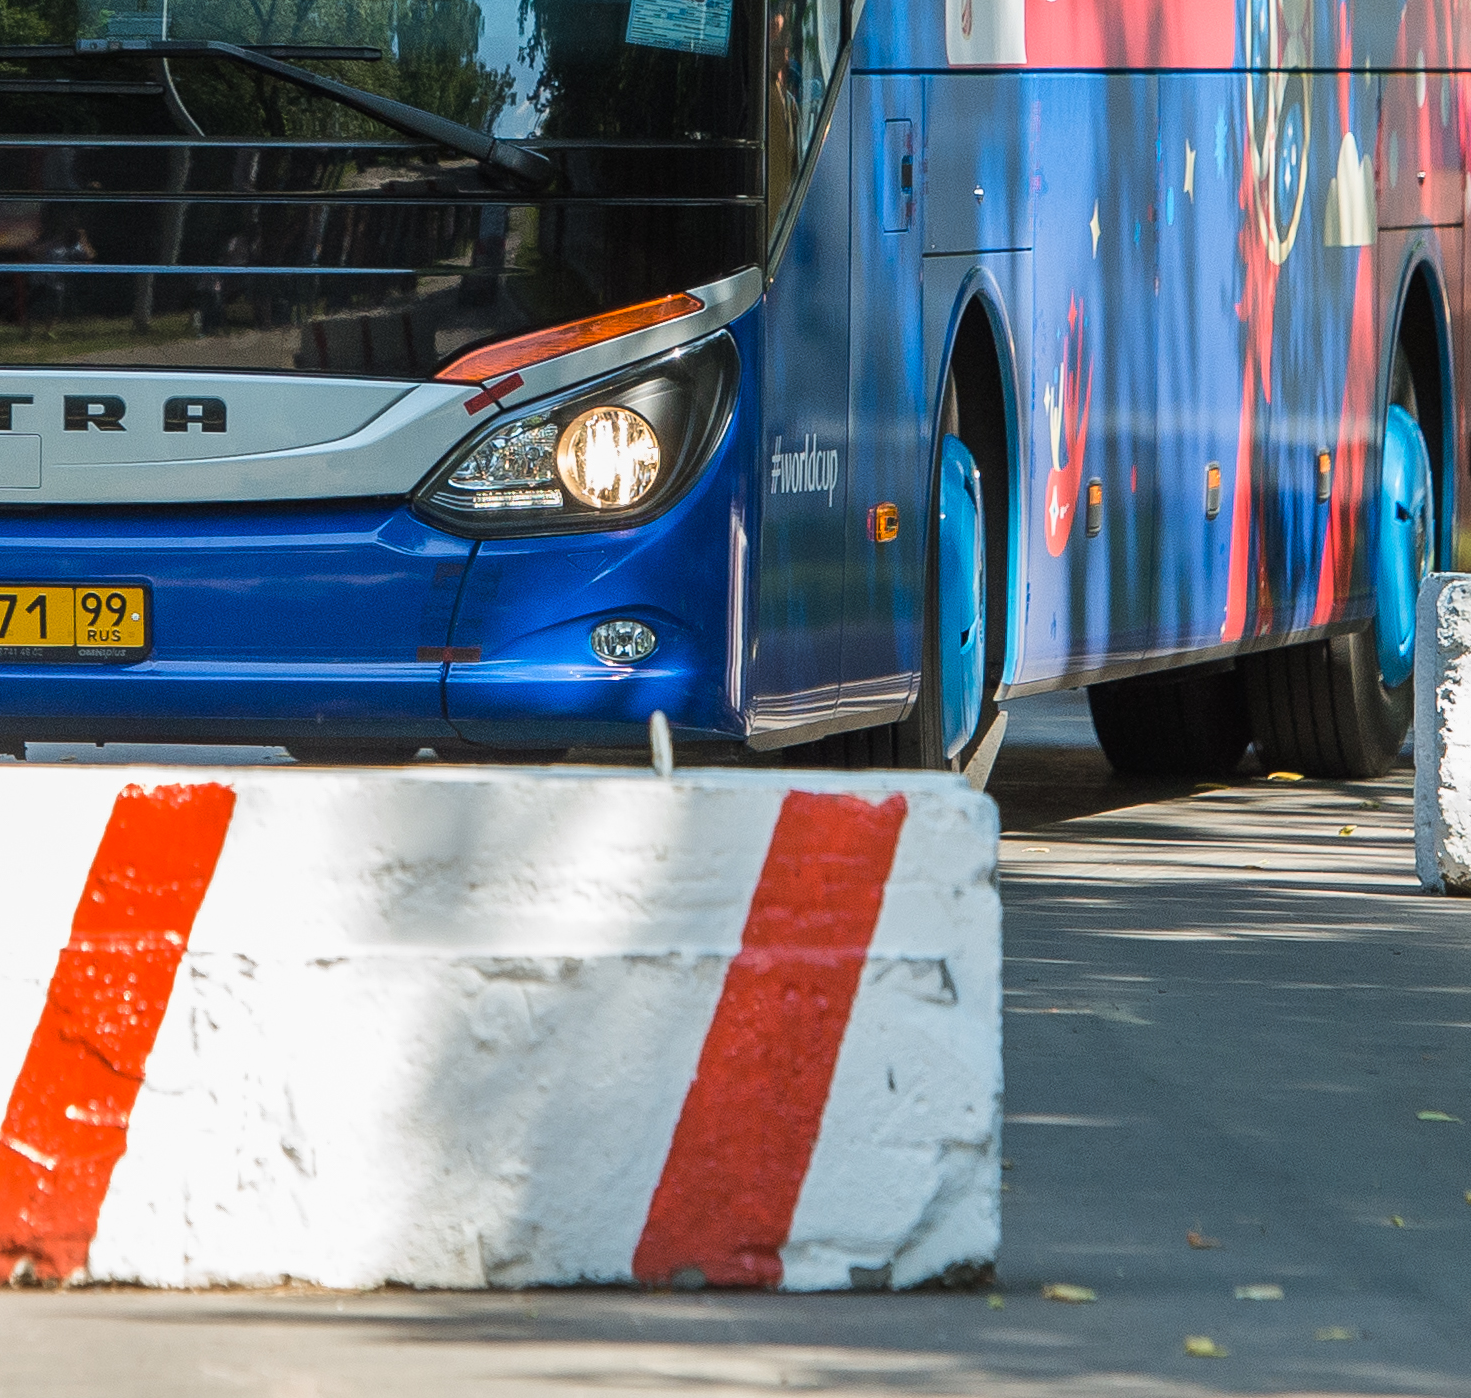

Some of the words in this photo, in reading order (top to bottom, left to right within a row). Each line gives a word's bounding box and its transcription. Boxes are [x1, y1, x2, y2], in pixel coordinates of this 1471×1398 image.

[771, 433, 838, 508] #worldcup
[81, 591, 127, 628] 99
[87, 629, 122, 642] RUS
